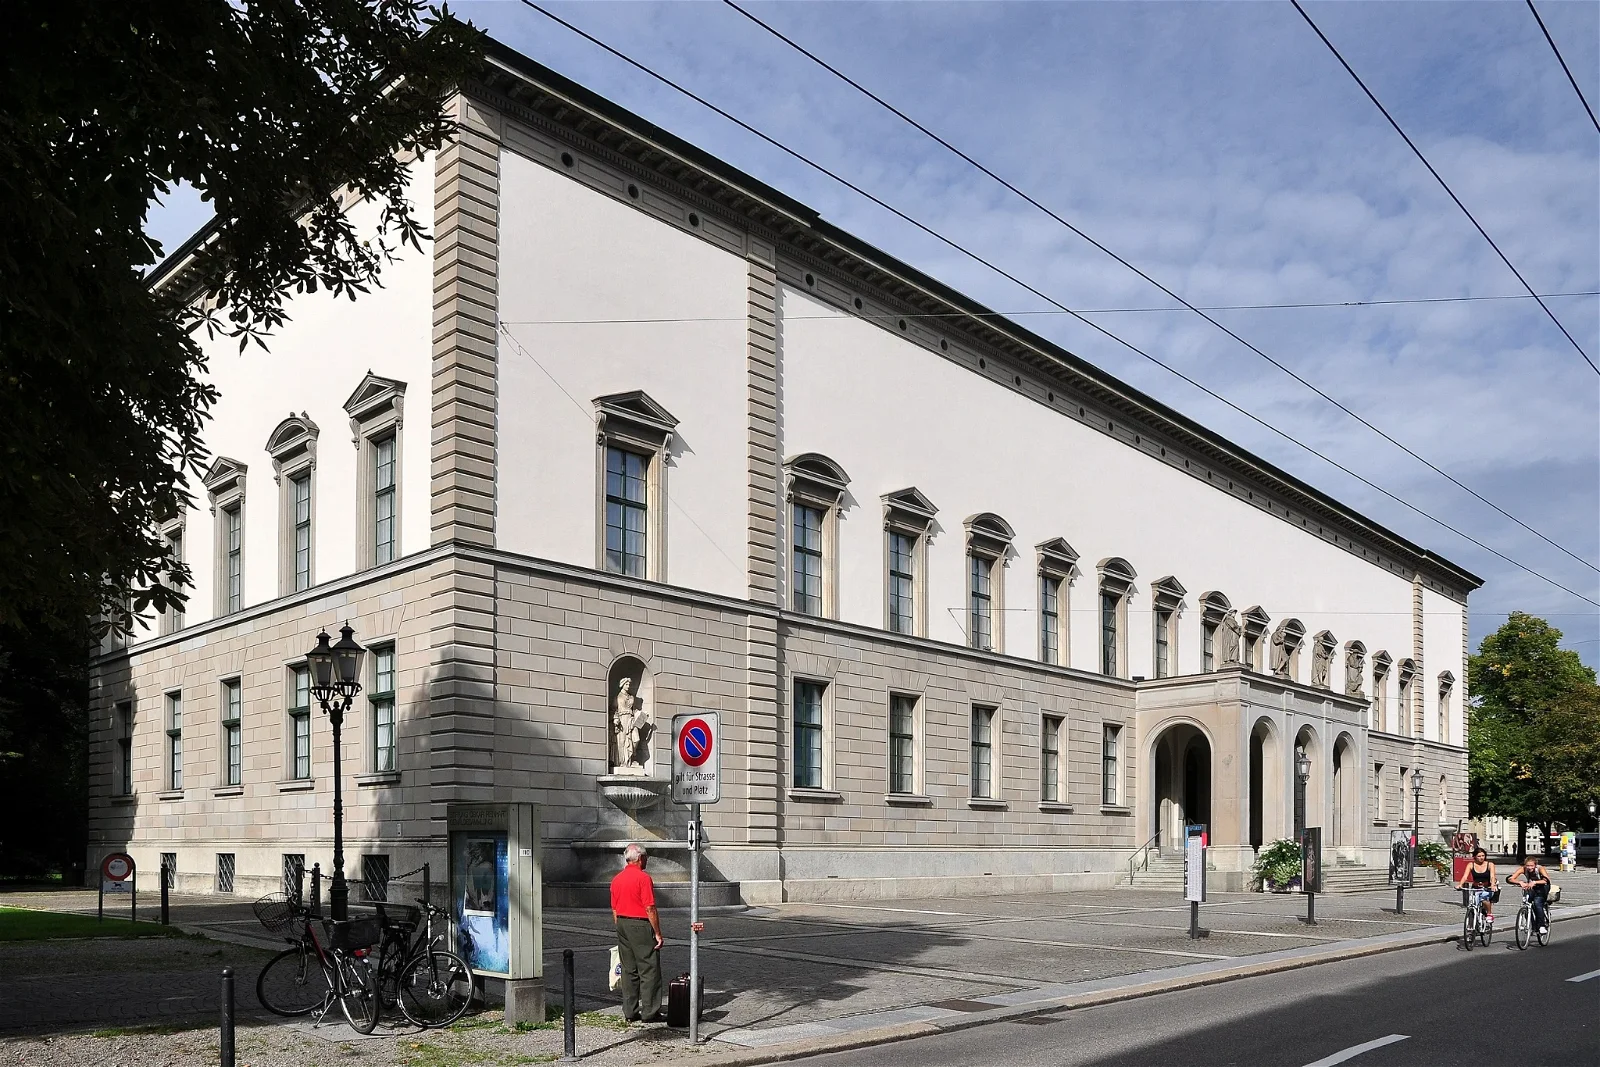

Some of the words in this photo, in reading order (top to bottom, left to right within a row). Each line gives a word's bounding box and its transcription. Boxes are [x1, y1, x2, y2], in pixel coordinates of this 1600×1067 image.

[675, 772, 685, 784] gilt
[686, 772, 694, 781] für
[695, 771, 715, 781] Strasse
[682, 785, 693, 795] und
[694, 785, 708, 795] Platz
